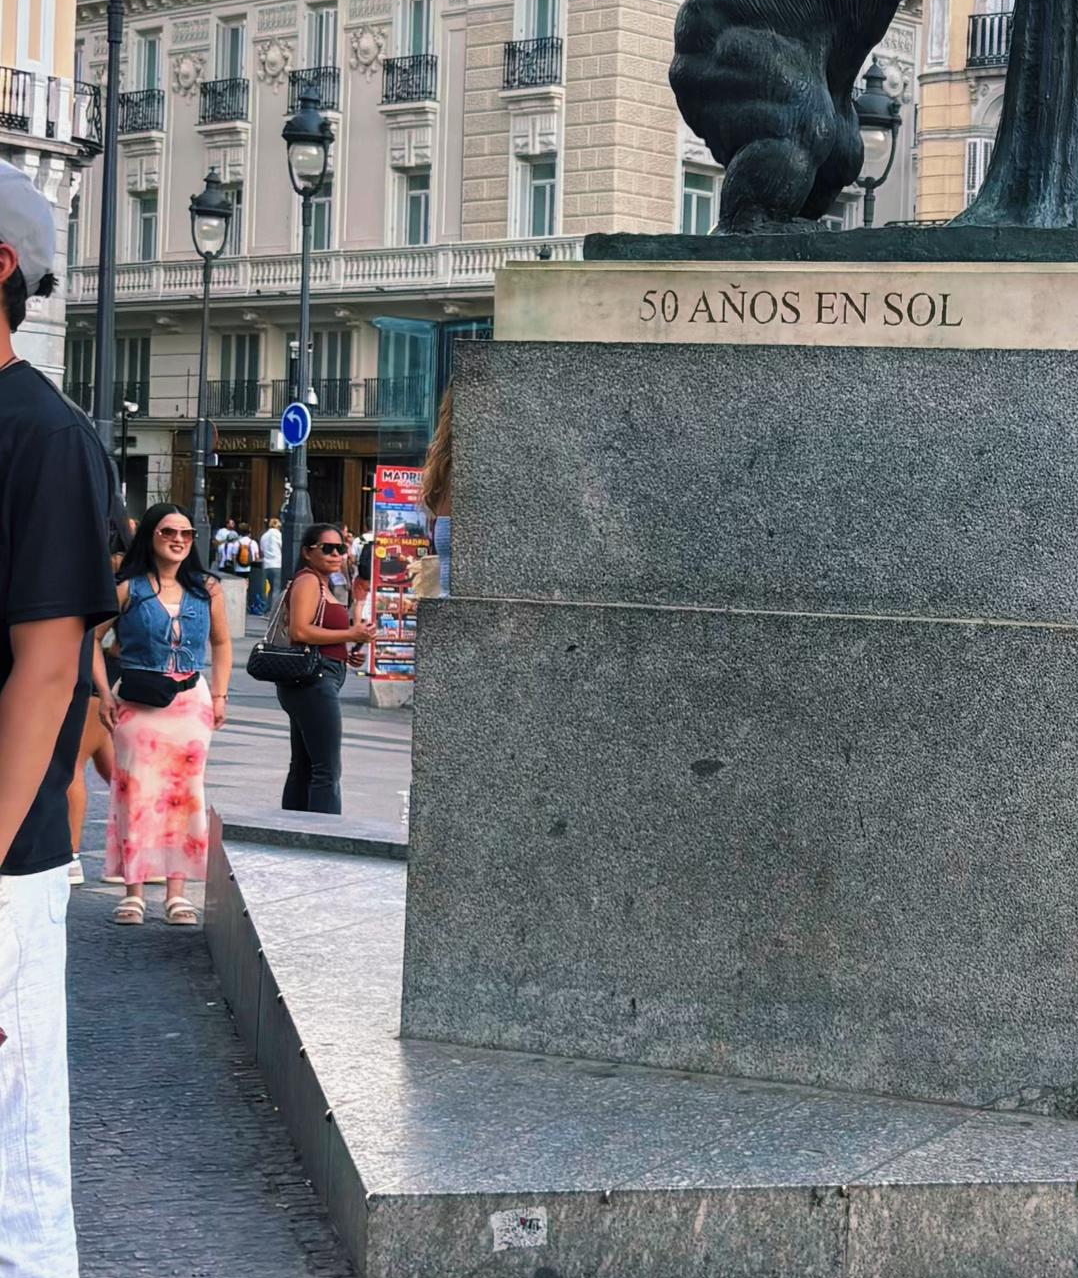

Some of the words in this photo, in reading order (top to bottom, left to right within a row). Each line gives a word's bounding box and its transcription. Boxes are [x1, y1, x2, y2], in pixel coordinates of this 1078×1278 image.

[638, 289, 679, 323] 50
[688, 283, 801, 324] AÑOS
[814, 291, 871, 325] EN
[882, 292, 964, 327] SOL
[383, 470, 421, 483] MADRI
